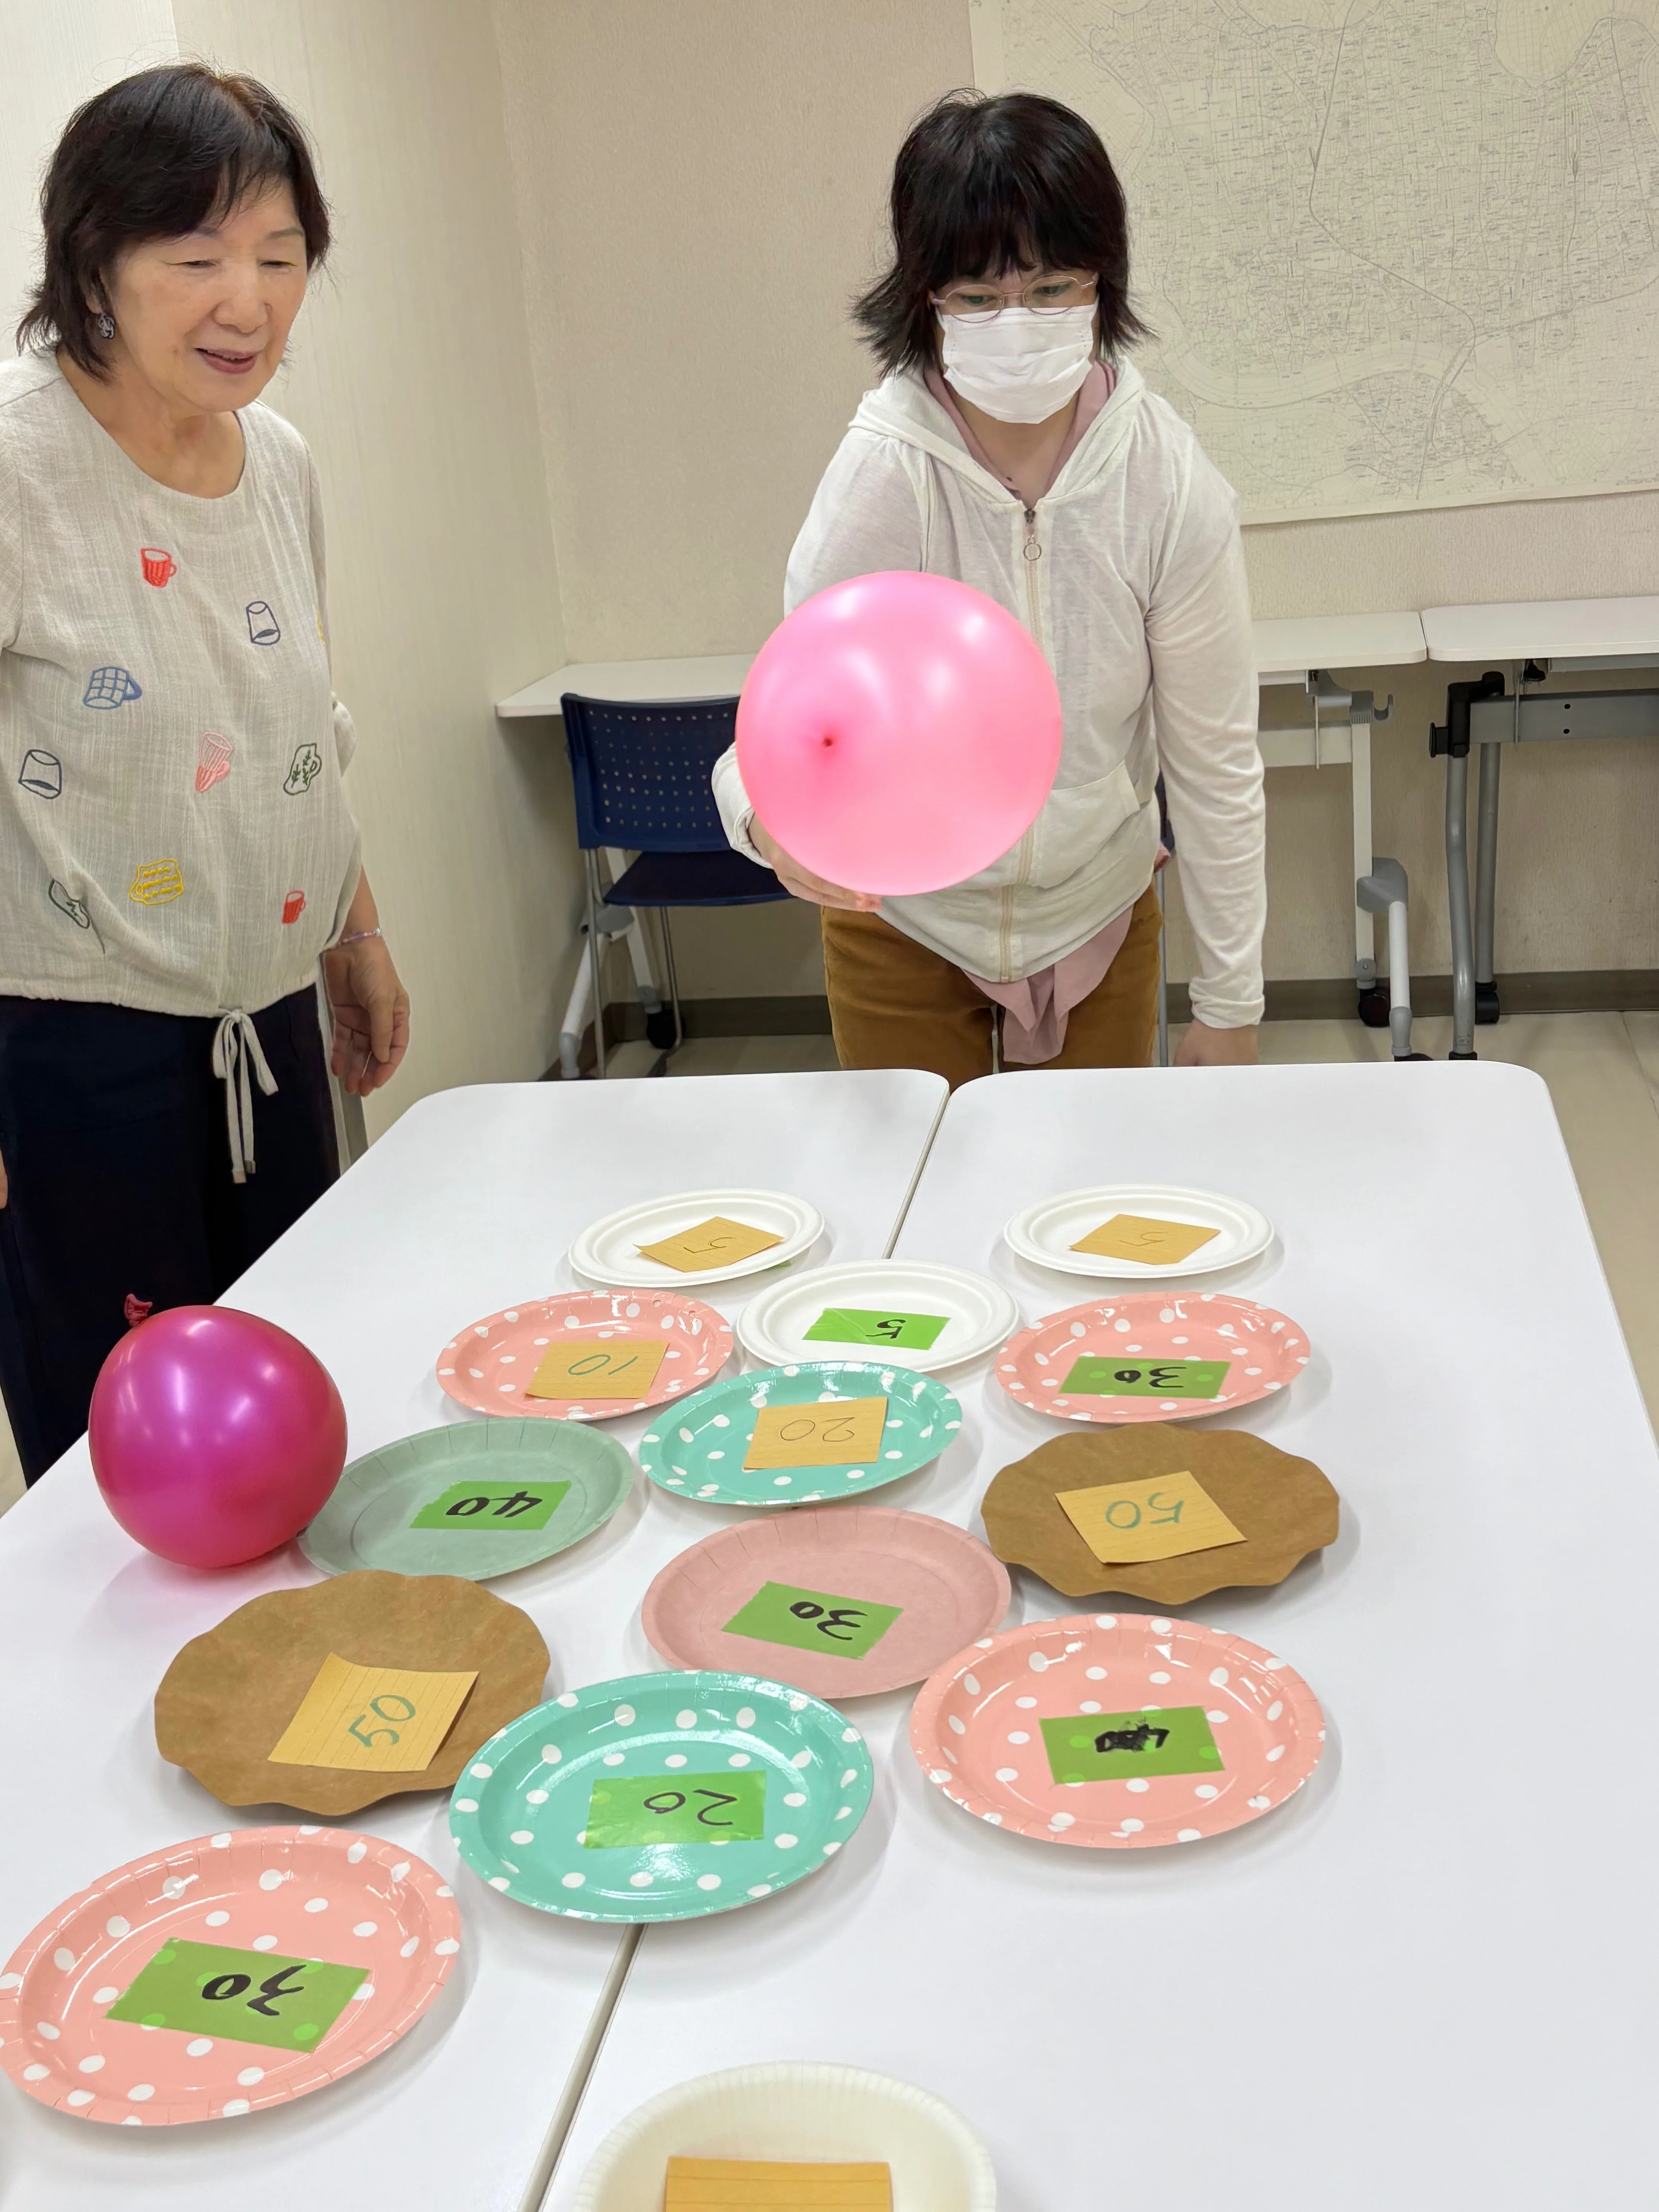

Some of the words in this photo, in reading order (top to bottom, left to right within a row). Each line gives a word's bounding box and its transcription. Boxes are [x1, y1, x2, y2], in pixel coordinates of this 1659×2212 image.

[683, 1237, 737, 1254] 5
[1119, 1231, 1169, 1247] 5
[866, 1319, 907, 1339] 5
[568, 1354, 639, 1376] 10
[1114, 1366, 1187, 1388] 30
[780, 1417, 855, 1442] 20
[446, 1491, 543, 1518] 40
[1105, 1492, 1185, 1529] 50
[789, 1601, 868, 1640] 30
[348, 1694, 416, 1748] 50
[643, 1789, 738, 1826] 20
[202, 1964, 307, 2016] 30
